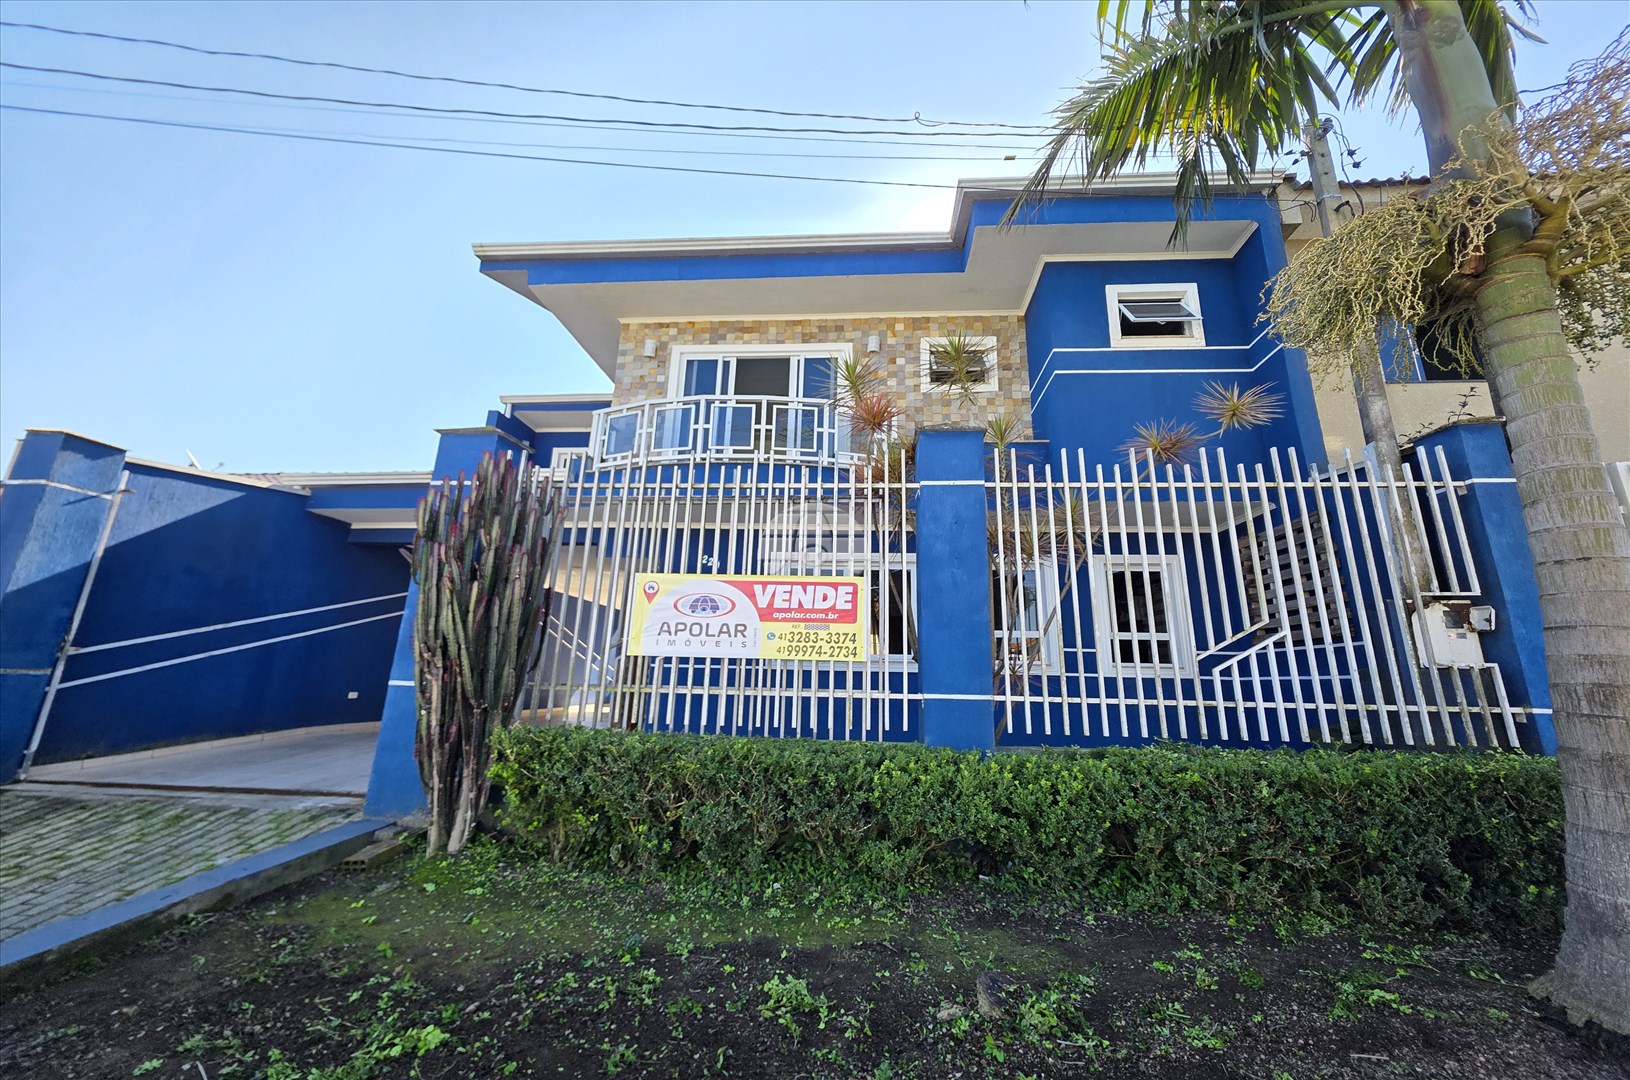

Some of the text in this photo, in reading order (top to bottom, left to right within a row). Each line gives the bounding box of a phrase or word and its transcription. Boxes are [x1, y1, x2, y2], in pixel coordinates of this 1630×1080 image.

[753, 584, 854, 610] VENDE
[773, 611, 839, 620] apolar.com.br
[657, 621, 748, 638] APOLAR
